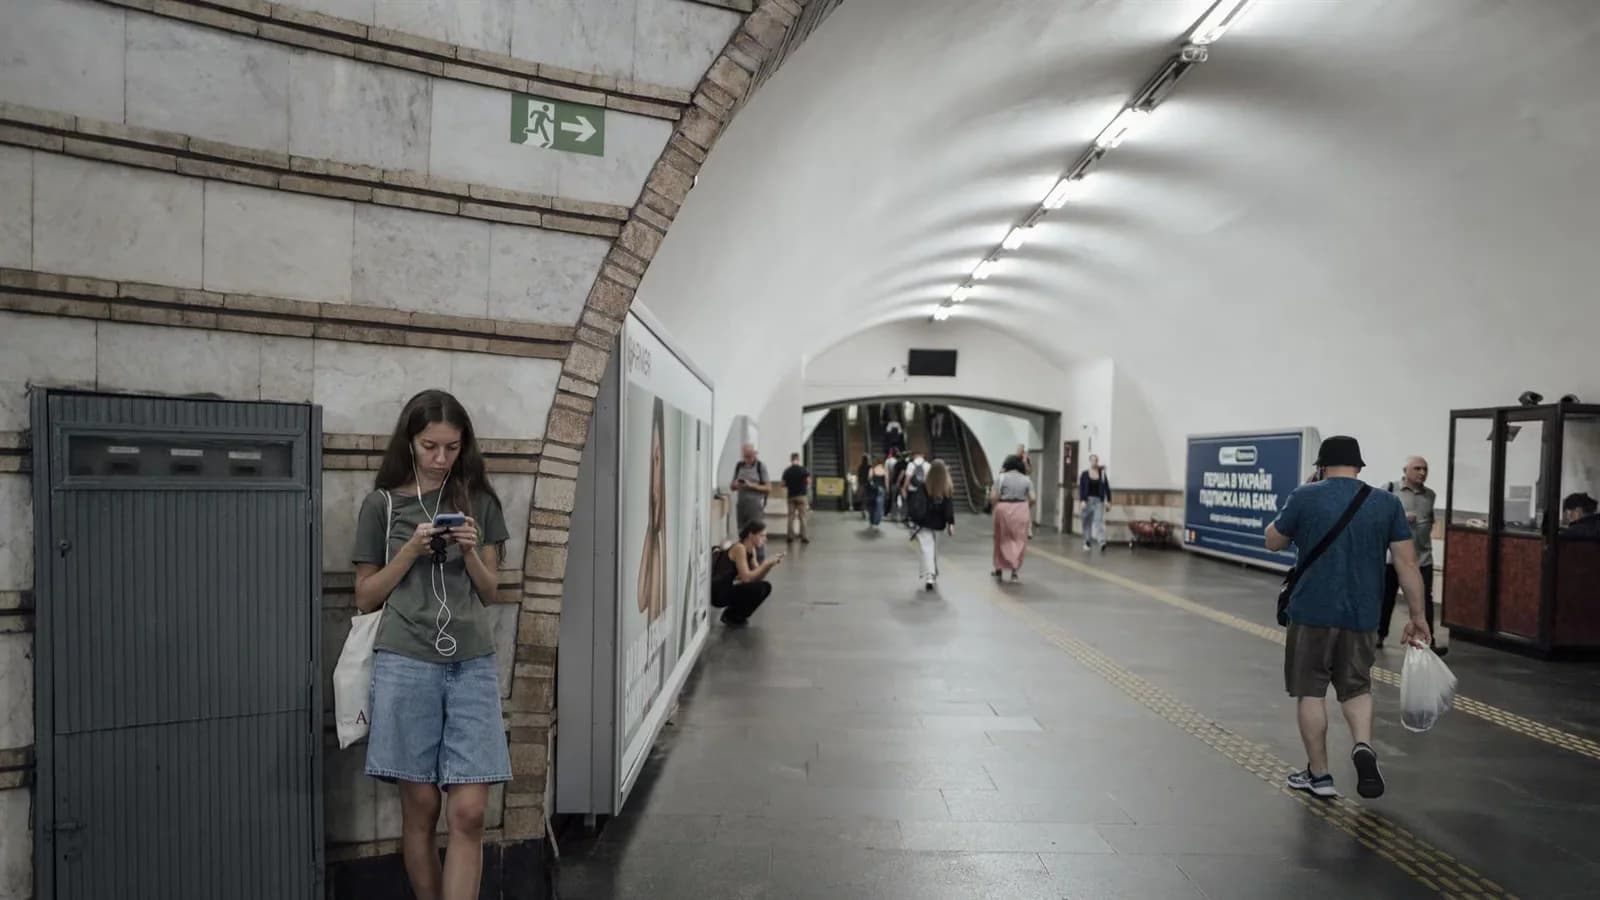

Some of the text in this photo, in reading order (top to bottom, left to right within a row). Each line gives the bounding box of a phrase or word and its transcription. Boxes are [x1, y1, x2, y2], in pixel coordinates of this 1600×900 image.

[1203, 468, 1272, 491] ПЕРША В УКРАЇНІ
[1200, 489, 1278, 512] ПІДПИСКА НА БАНК
